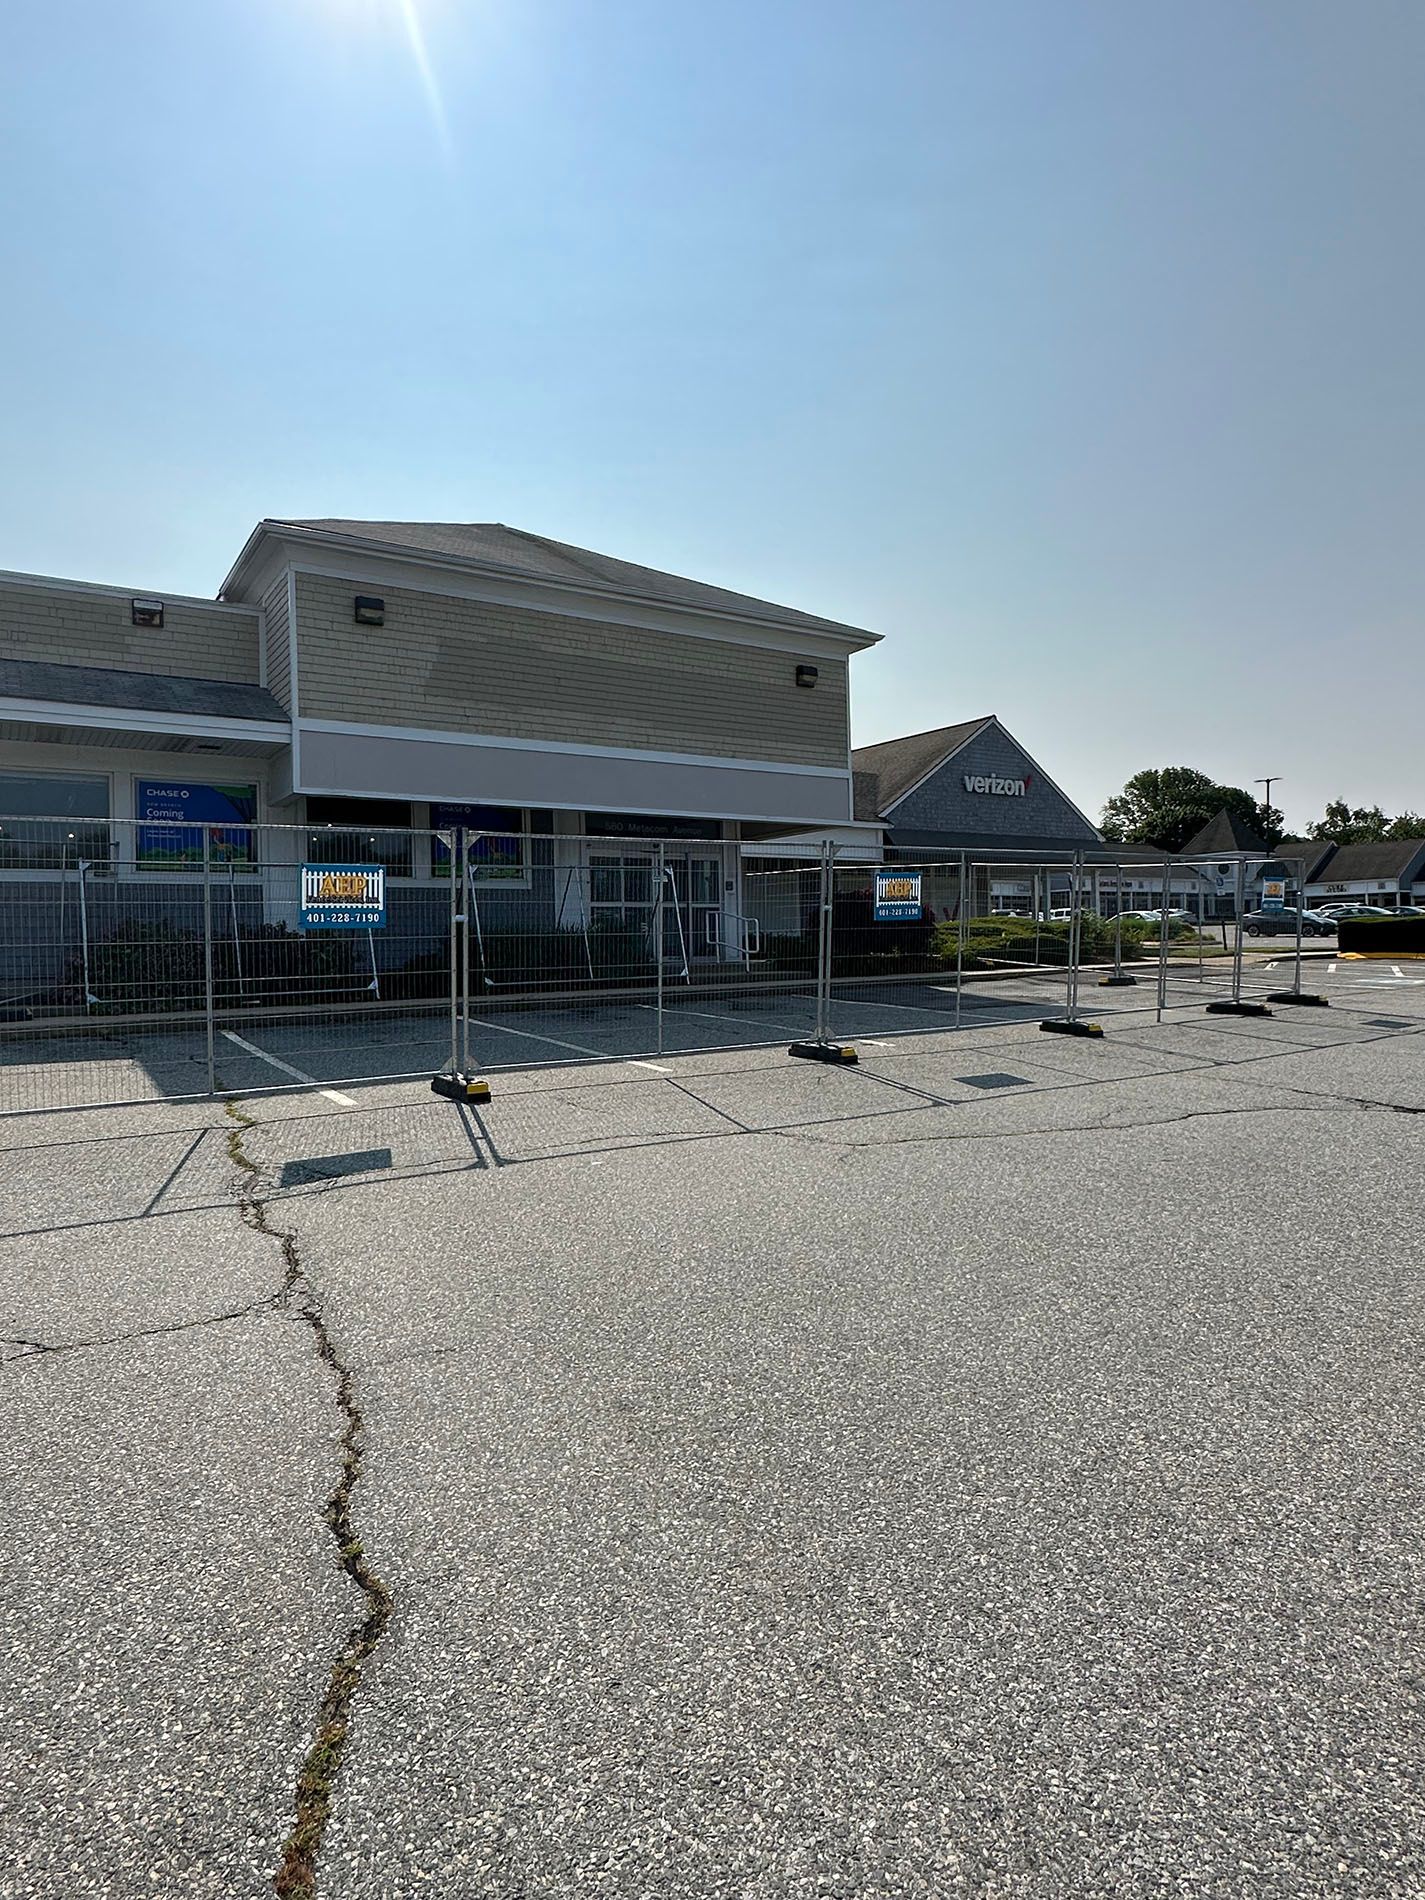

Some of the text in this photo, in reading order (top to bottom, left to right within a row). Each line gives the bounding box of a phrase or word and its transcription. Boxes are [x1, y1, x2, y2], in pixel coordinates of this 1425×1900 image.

[964, 773, 1025, 796] verizon
[146, 788, 180, 798] CHASE
[146, 807, 185, 820] Coming
[318, 875, 367, 896] AEP
[306, 912, 380, 923] 401-228-7190
